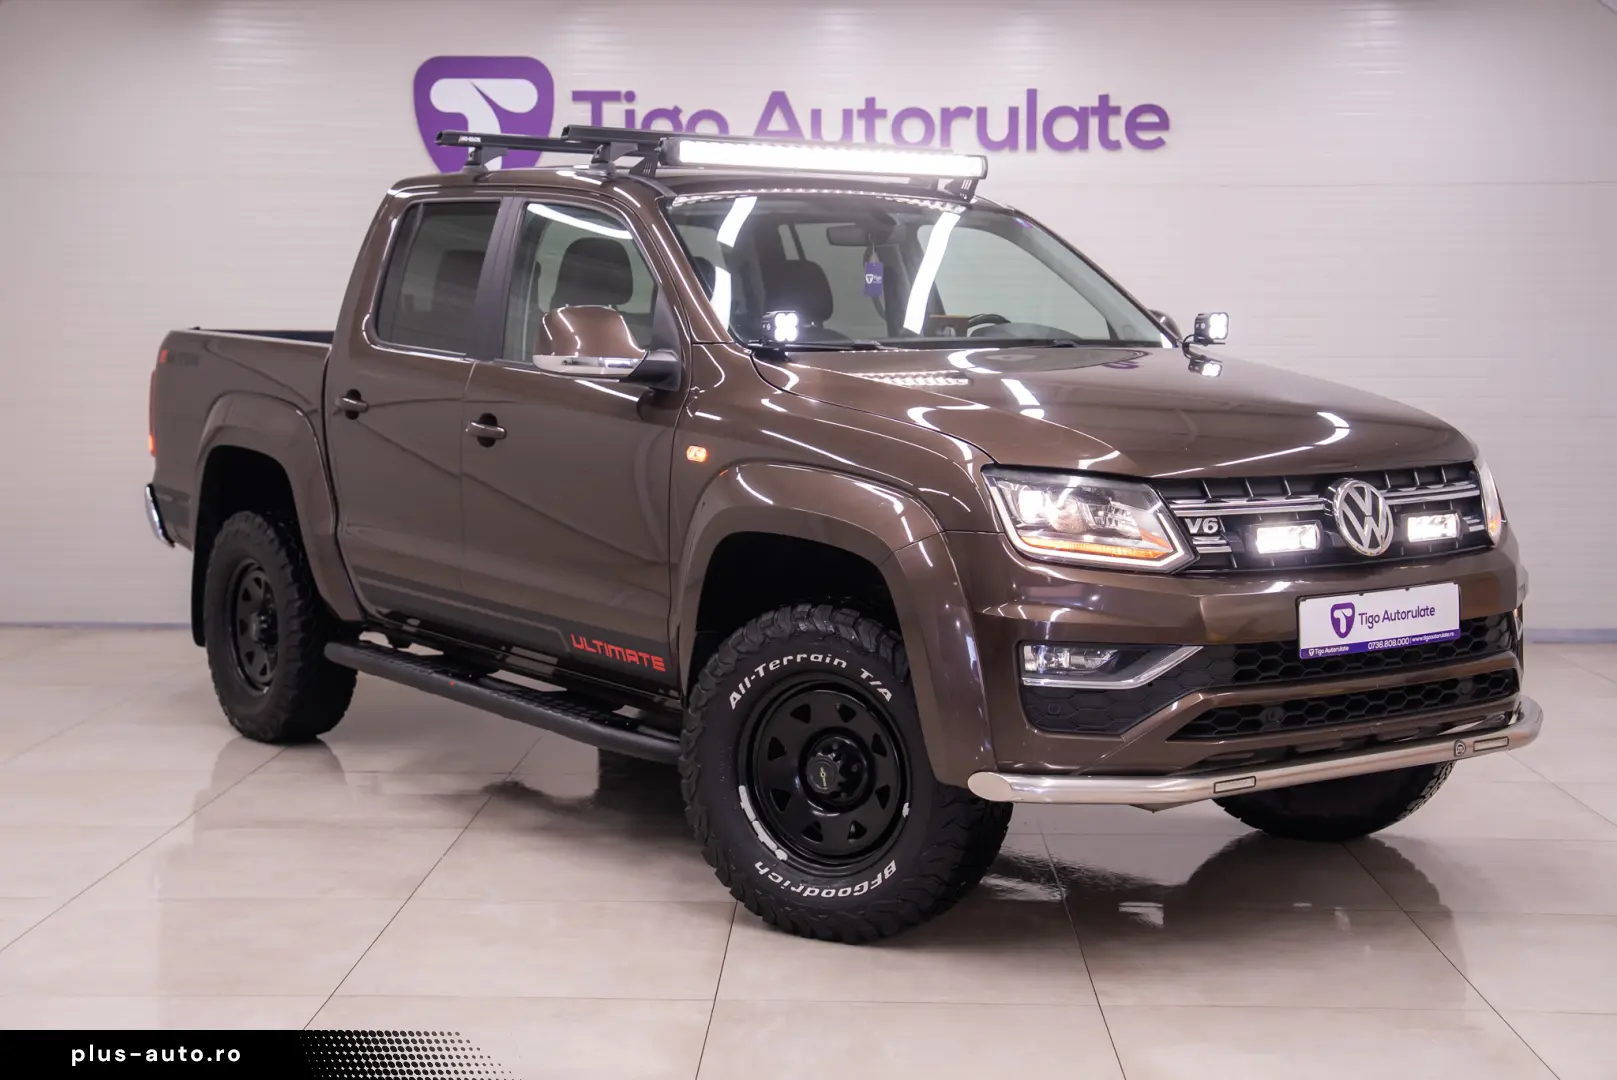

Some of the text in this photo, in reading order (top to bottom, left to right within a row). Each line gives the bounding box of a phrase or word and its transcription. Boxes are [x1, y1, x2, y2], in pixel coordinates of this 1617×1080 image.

[753, 87, 1171, 152] Autorulate
[1184, 517, 1219, 535] V6
[1358, 605, 1435, 629] Tigo Autorulate
[571, 633, 666, 672] ULTIMATE
[1314, 645, 1350, 656] Tigo Autorulate
[729, 652, 893, 710] All-Terrain T/A
[754, 859, 897, 898] BFGoodrich
